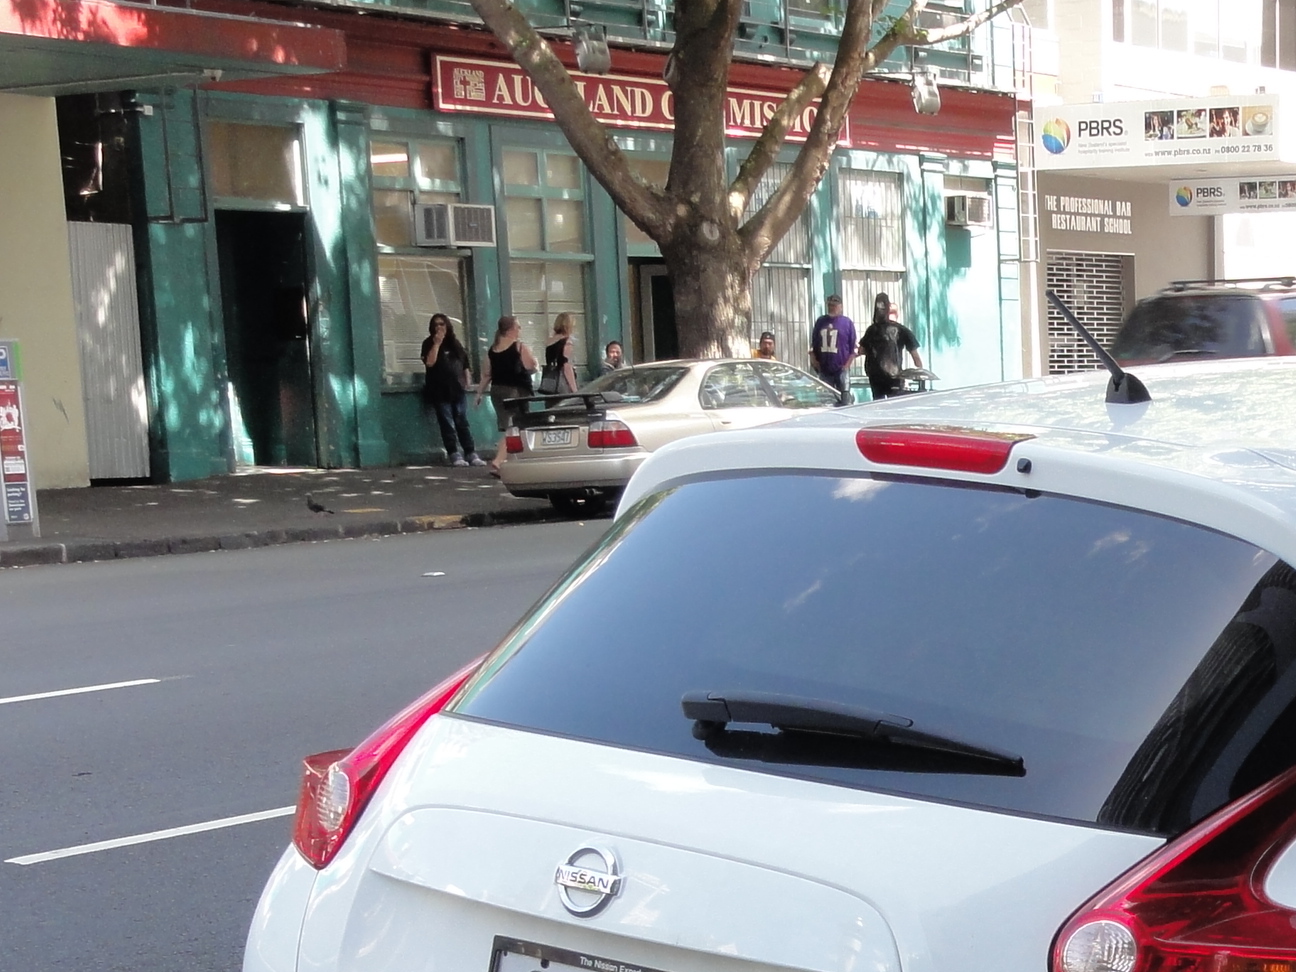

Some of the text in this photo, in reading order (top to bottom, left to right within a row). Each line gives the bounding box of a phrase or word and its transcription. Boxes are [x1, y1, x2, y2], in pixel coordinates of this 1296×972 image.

[493, 72, 654, 118] AUCLAND
[1078, 118, 1124, 138] PBRS
[1154, 147, 1211, 158] www.pbrs.co.nz
[1220, 145, 1240, 154] 0800
[1241, 145, 1251, 153] 22
[1252, 144, 1262, 153] 78
[1263, 143, 1274, 152] 36
[1196, 186, 1223, 198] PBRS
[1045, 194, 1132, 217] THE PROFESSIONAL BAR
[1052, 213, 1132, 235] RESTAURANT SCHOOL
[820, 328, 839, 354] 11
[556, 866, 611, 890] NISSAN
[579, 956, 594, 967] The
[594, 960, 618, 972] Nissan
